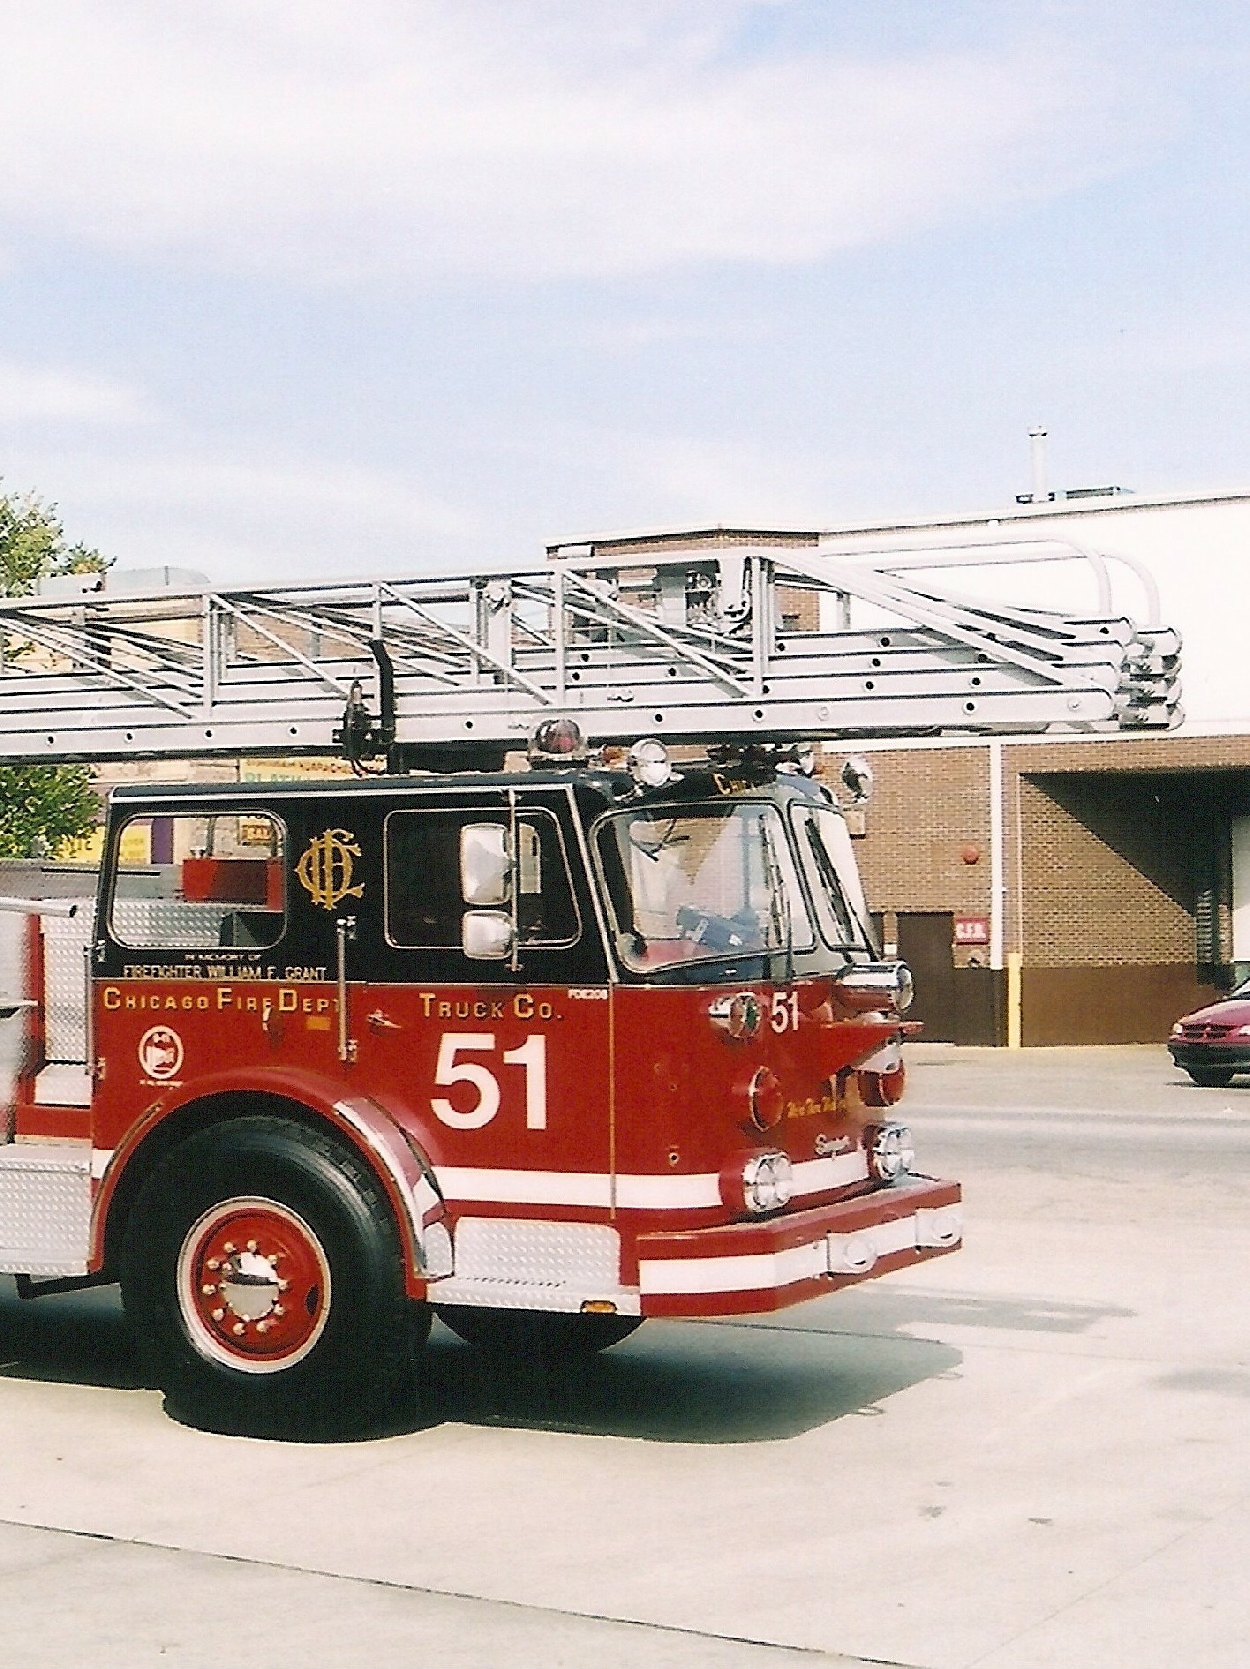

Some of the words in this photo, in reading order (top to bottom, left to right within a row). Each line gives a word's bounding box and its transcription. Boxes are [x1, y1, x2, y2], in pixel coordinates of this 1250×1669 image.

[123, 964, 202, 979] FIREFIGHTER
[207, 964, 263, 980] WILLIAM
[285, 966, 328, 981] GRANT
[104, 986, 211, 1010] CHICAGO
[217, 987, 272, 1012] FIRE
[419, 992, 505, 1018] TRUCK
[513, 993, 563, 1019] CO.
[771, 991, 799, 1033] 51
[430, 1032, 547, 1130] 51
